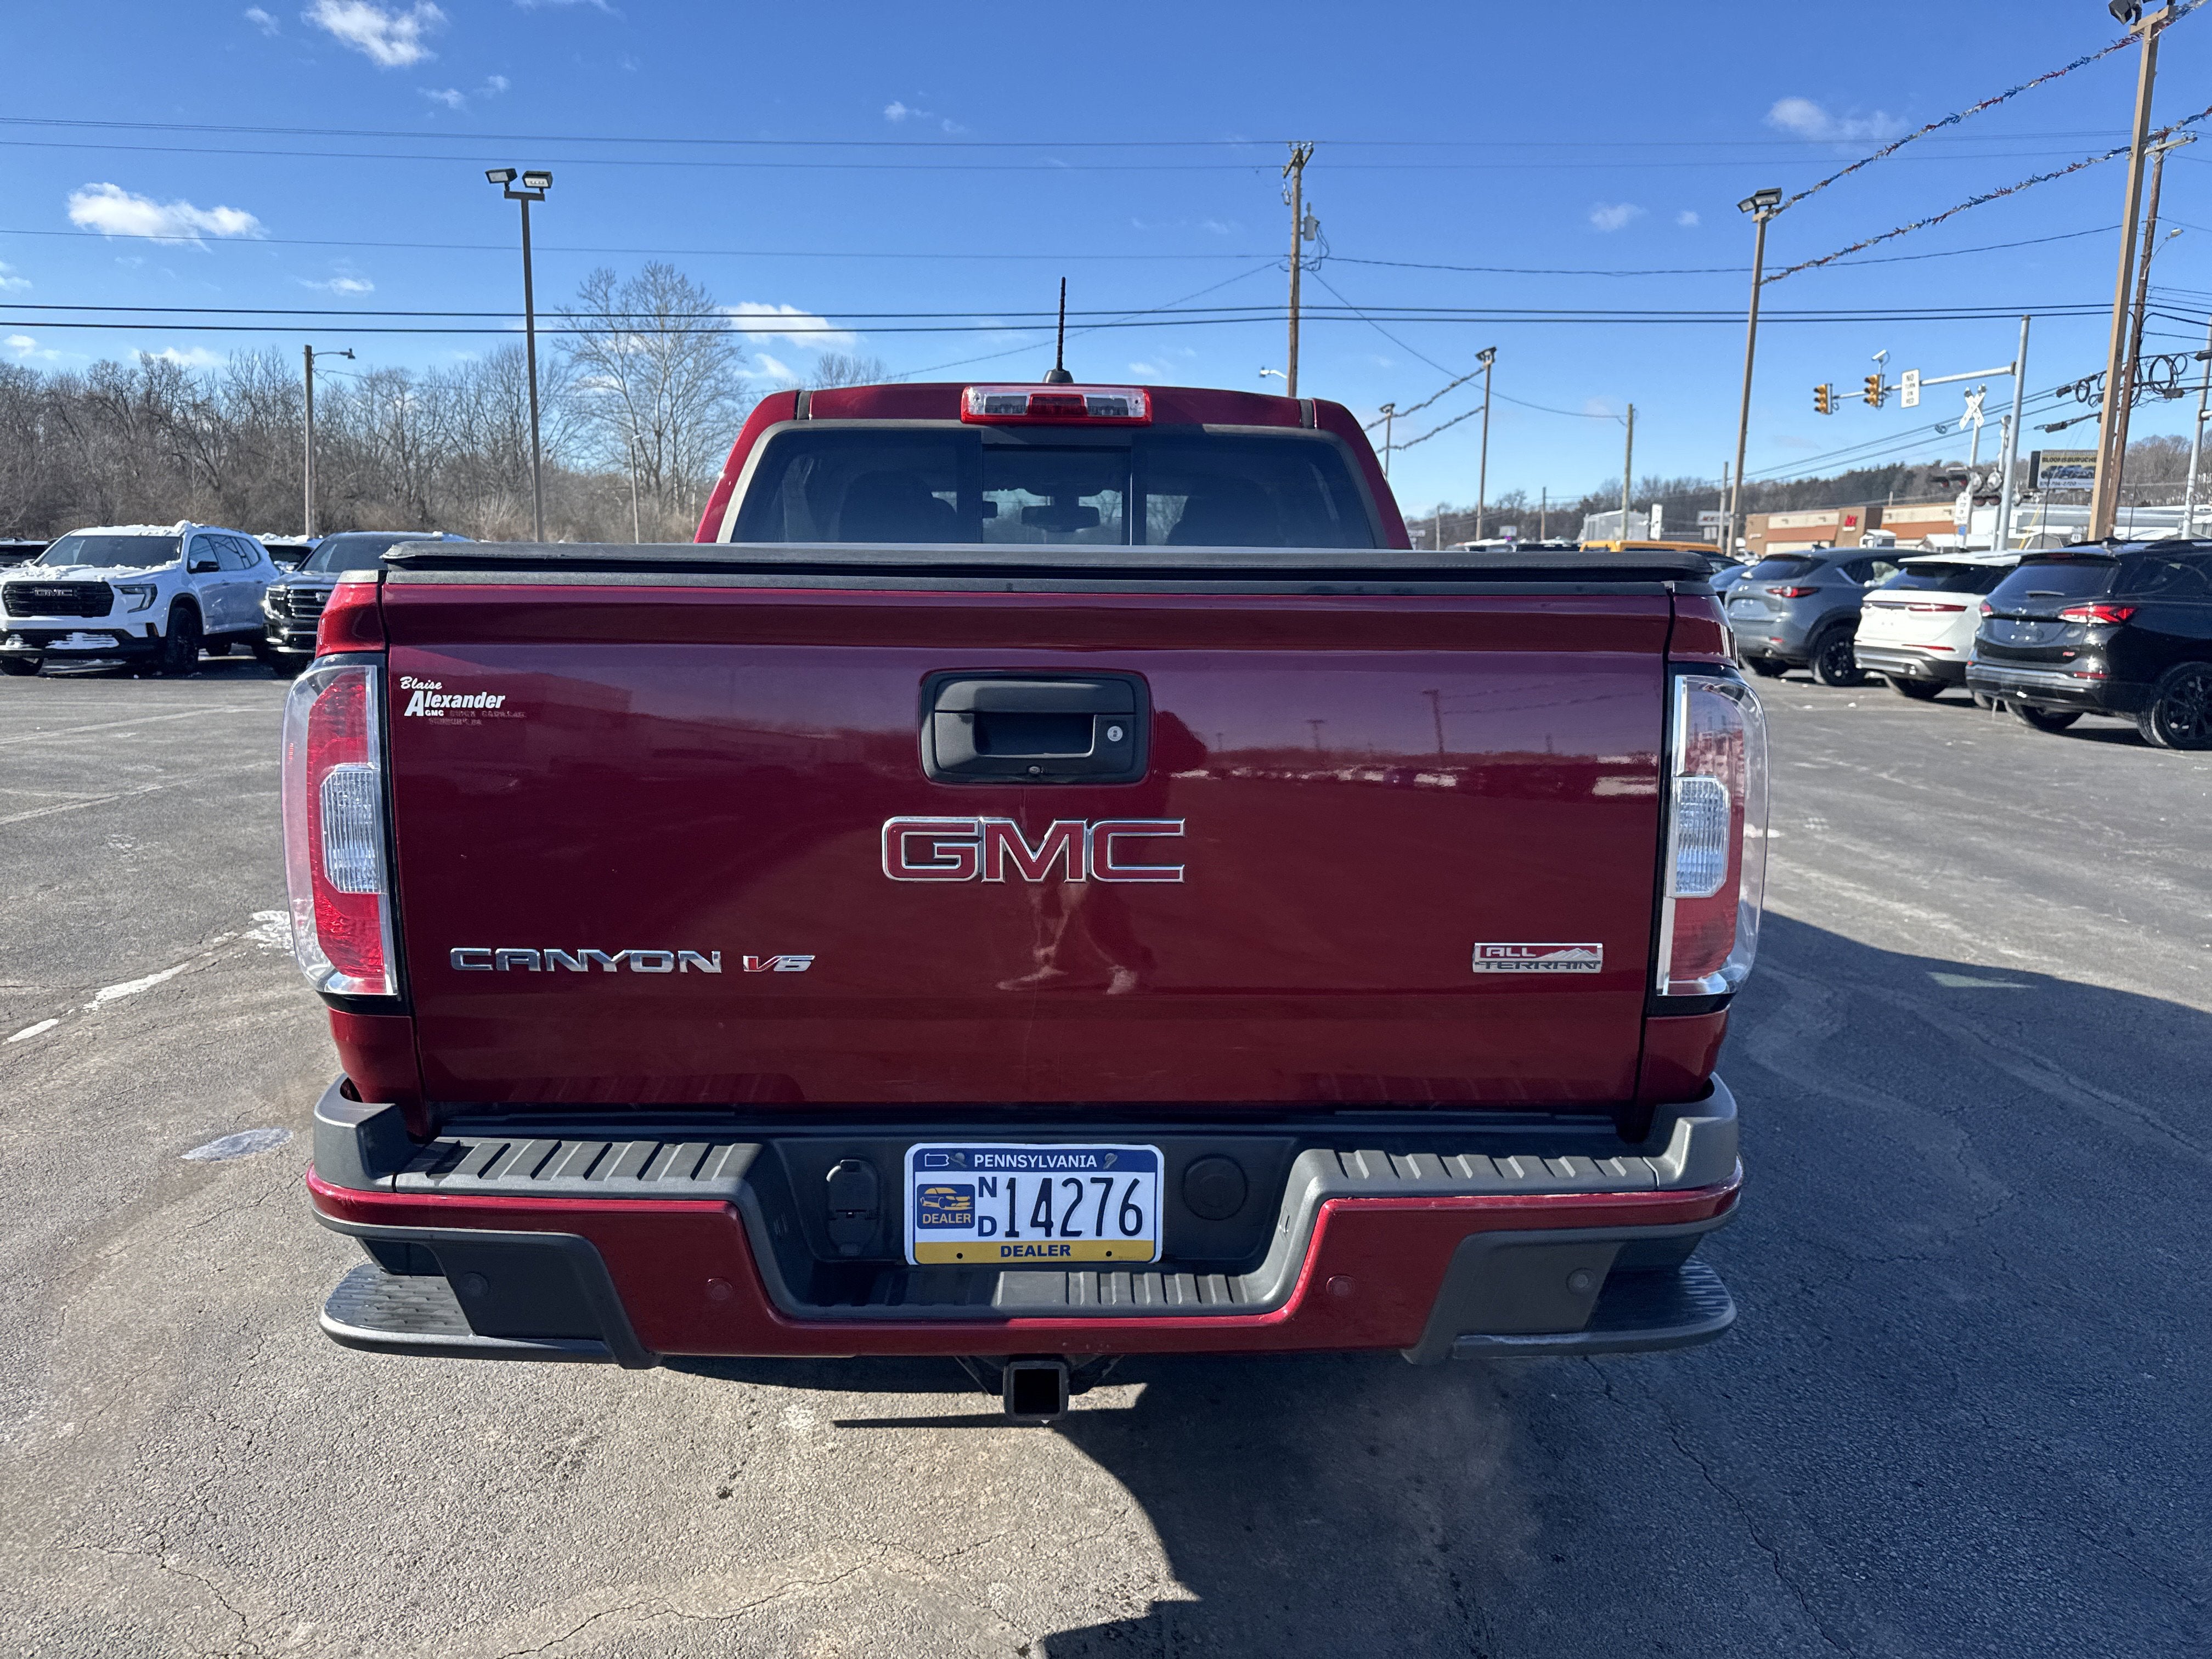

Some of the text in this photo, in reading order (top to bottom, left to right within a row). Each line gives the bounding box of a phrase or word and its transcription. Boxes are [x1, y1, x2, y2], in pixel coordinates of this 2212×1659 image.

[400, 676, 443, 690] Blaise
[404, 690, 506, 716] Alexander
[882, 816, 1185, 883] GMC
[1486, 947, 1537, 957] ALL
[449, 947, 816, 974] CANYON V6
[1475, 961, 1601, 970] TERRAIN
[974, 1154, 1097, 1169] PENNSYLVANIA
[1005, 1177, 1144, 1238] 14276
[922, 1214, 971, 1224] DEALER
[1001, 1244, 1071, 1257] DEALER
